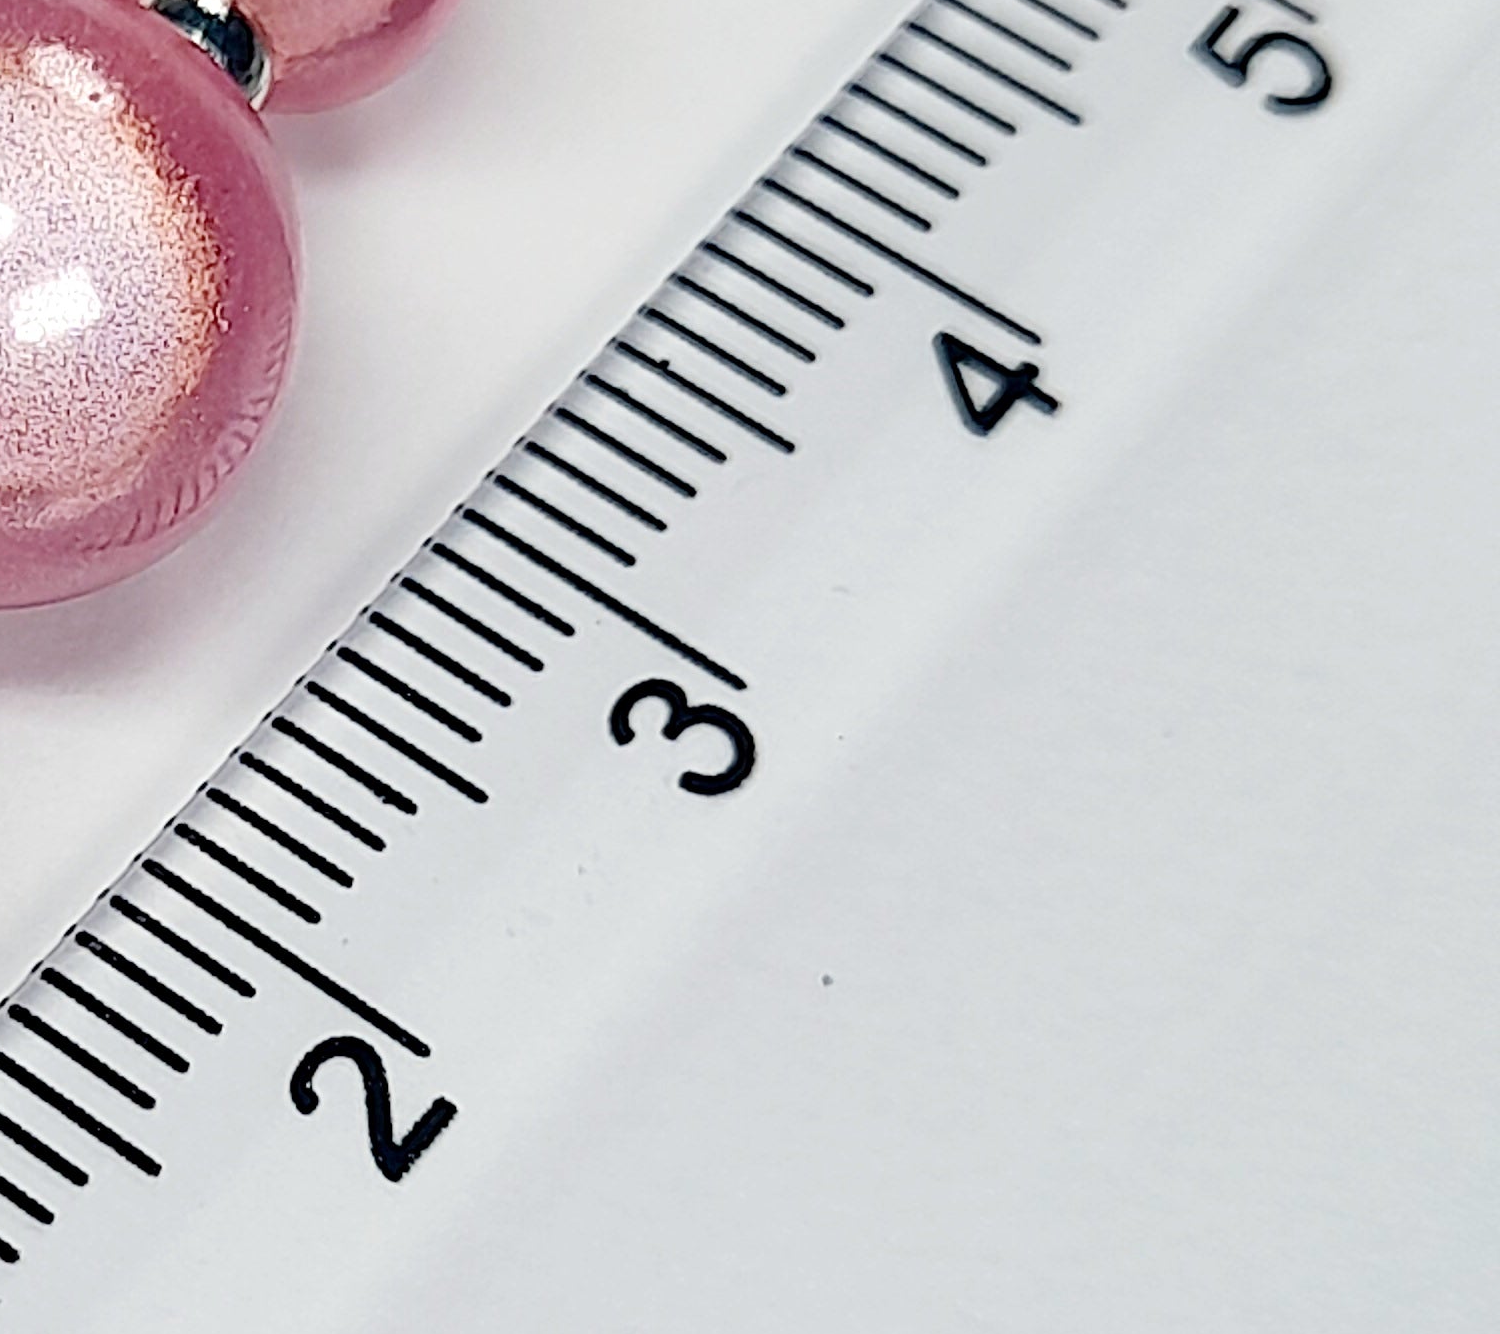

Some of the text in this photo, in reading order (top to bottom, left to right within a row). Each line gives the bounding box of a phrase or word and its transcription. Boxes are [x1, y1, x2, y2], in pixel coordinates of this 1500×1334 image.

[1193, 3, 1336, 116] 5
[932, 330, 1061, 438] 4
[607, 677, 758, 798] 3
[288, 1034, 459, 1184] 2
